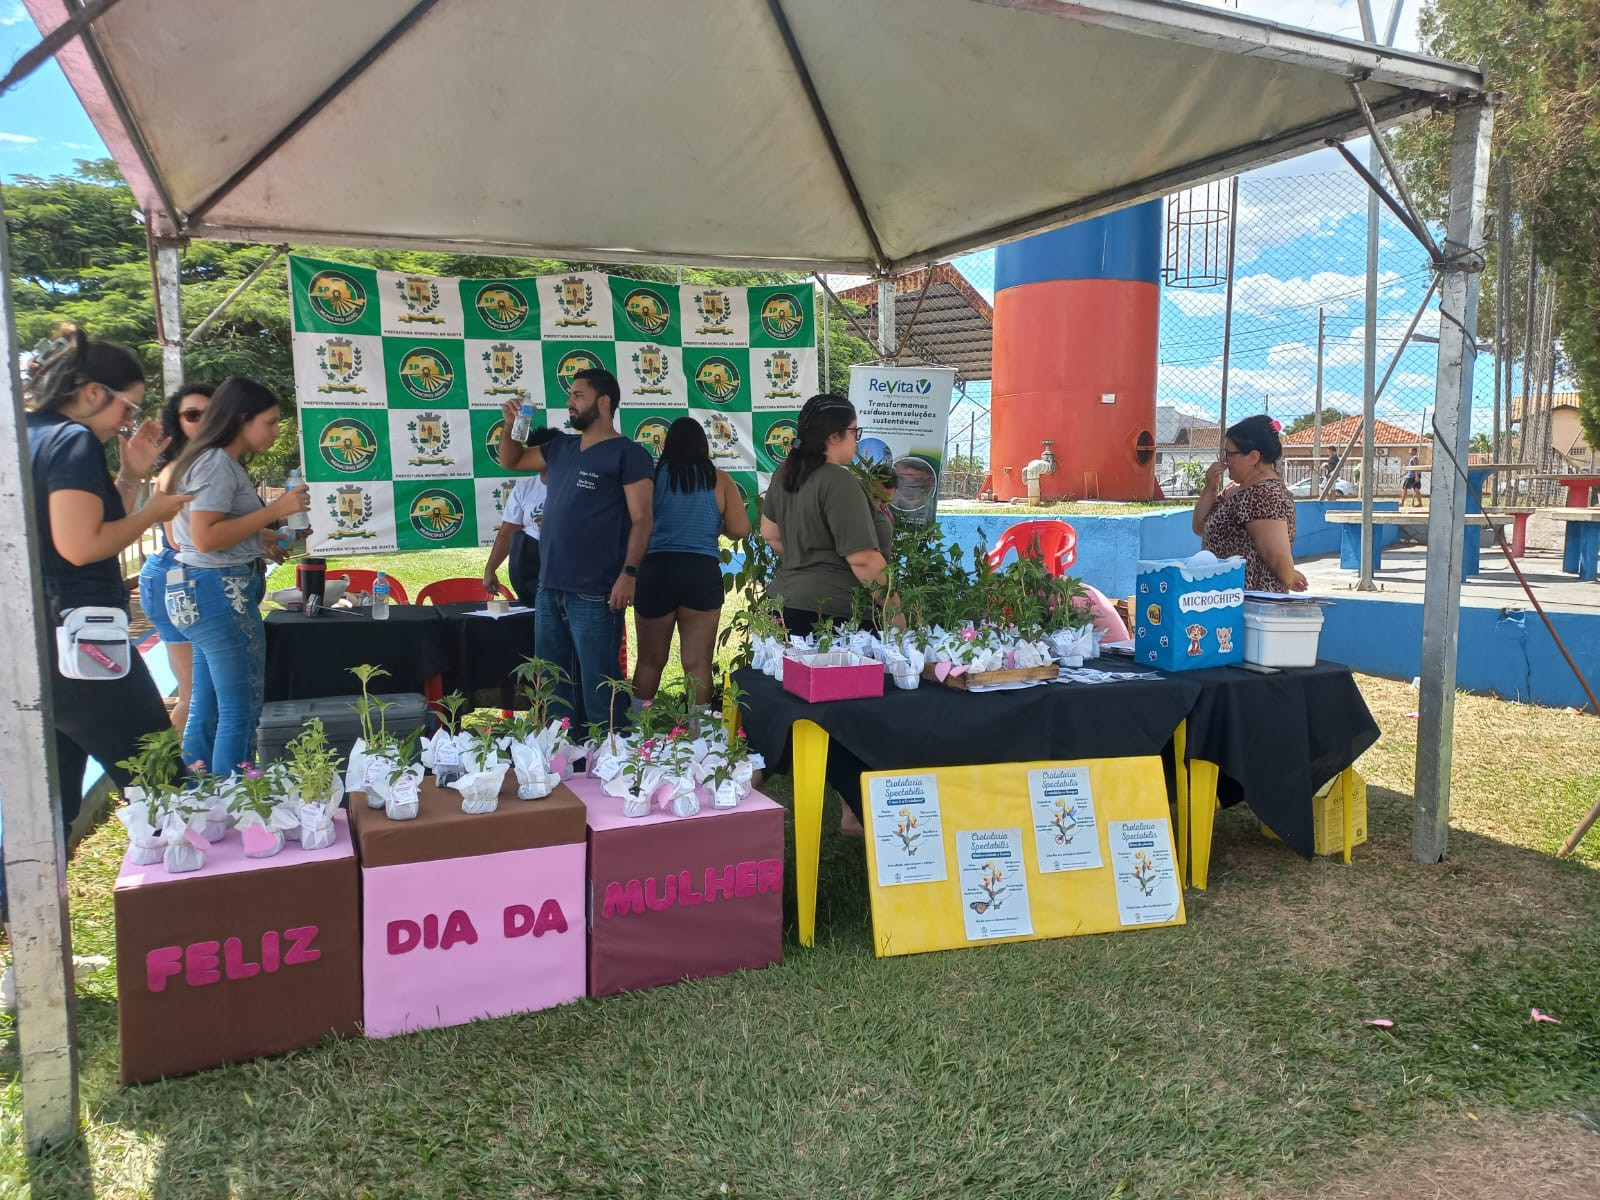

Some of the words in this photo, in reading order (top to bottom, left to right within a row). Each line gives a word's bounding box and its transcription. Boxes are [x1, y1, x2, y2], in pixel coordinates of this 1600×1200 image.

[869, 378, 914, 394] ReVita
[868, 400, 928, 409] Transformamos
[859, 407, 891, 416] resíduos
[903, 410, 936, 420] soluções
[872, 417, 919, 426] sustentáveis
[1182, 592, 1240, 607] MICROCHIPS
[601, 859, 783, 920] MULHER
[386, 909, 479, 956] DIA
[503, 898, 569, 939] DA
[146, 924, 322, 993] FELIZ
